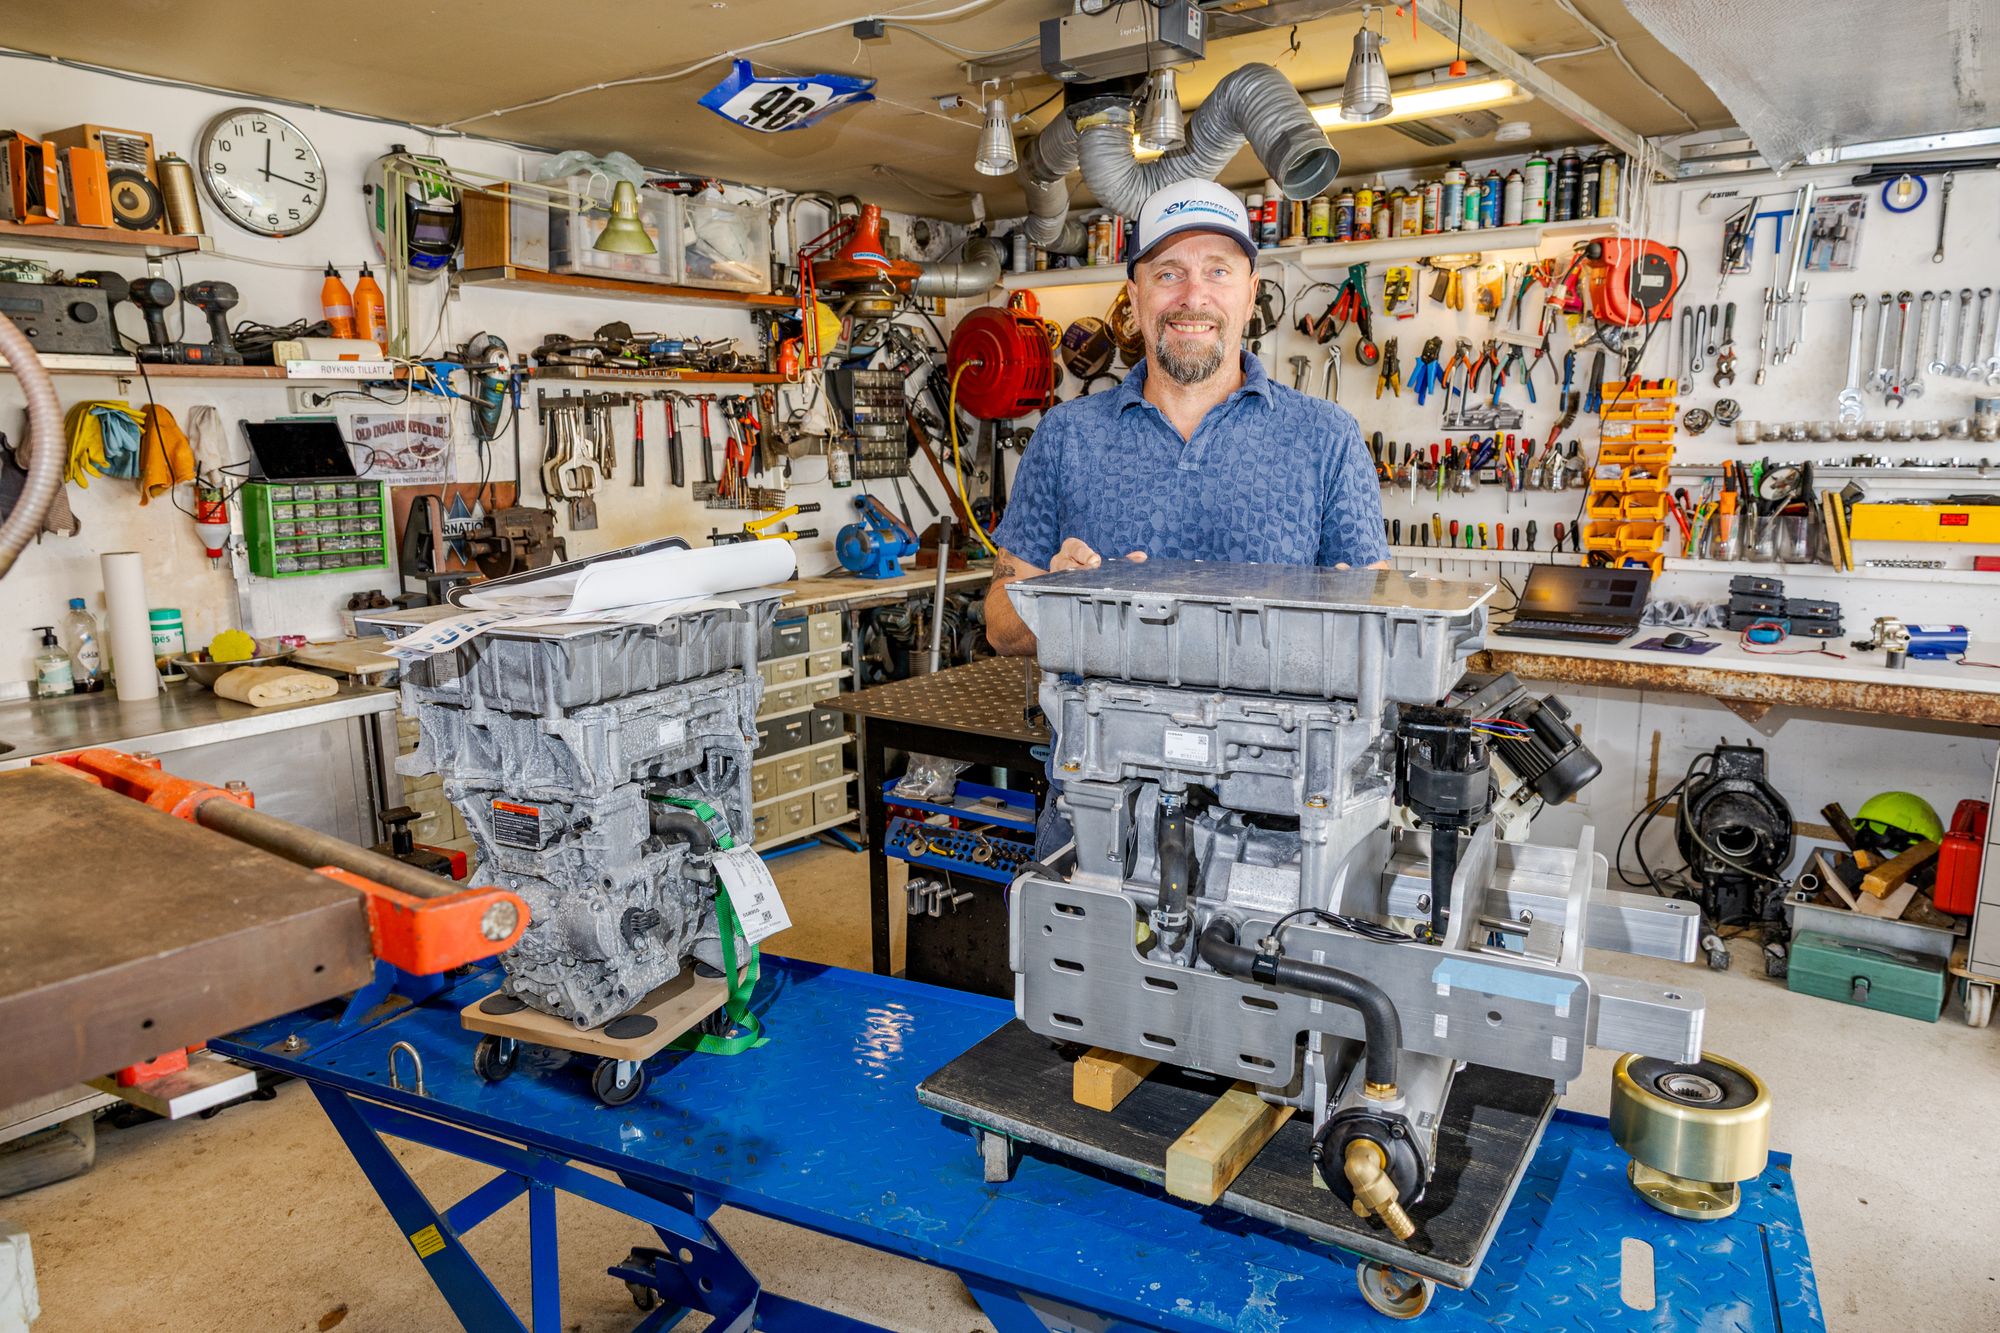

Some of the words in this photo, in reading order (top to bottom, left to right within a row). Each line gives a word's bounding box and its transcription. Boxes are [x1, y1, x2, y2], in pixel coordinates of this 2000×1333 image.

[748, 86, 816, 130] 46
[234, 124, 243, 136] 11
[252, 121, 267, 133] 12
[281, 130, 285, 142] 1
[219, 139, 231, 152] 10
[295, 148, 306, 160] 2
[214, 163, 226, 174] 9
[304, 171, 316, 183] 3
[302, 194, 312, 205] 4
[244, 204, 253, 217] 7
[288, 208, 300, 220] 5
[267, 213, 279, 225] 6
[320, 365, 355, 375] RØYKING
[357, 365, 385, 375] TILLATT
[355, 427, 371, 441] OLD
[373, 420, 406, 438] INDIANS
[409, 420, 431, 437] NEVER
[1166, 809, 1173, 817] F
